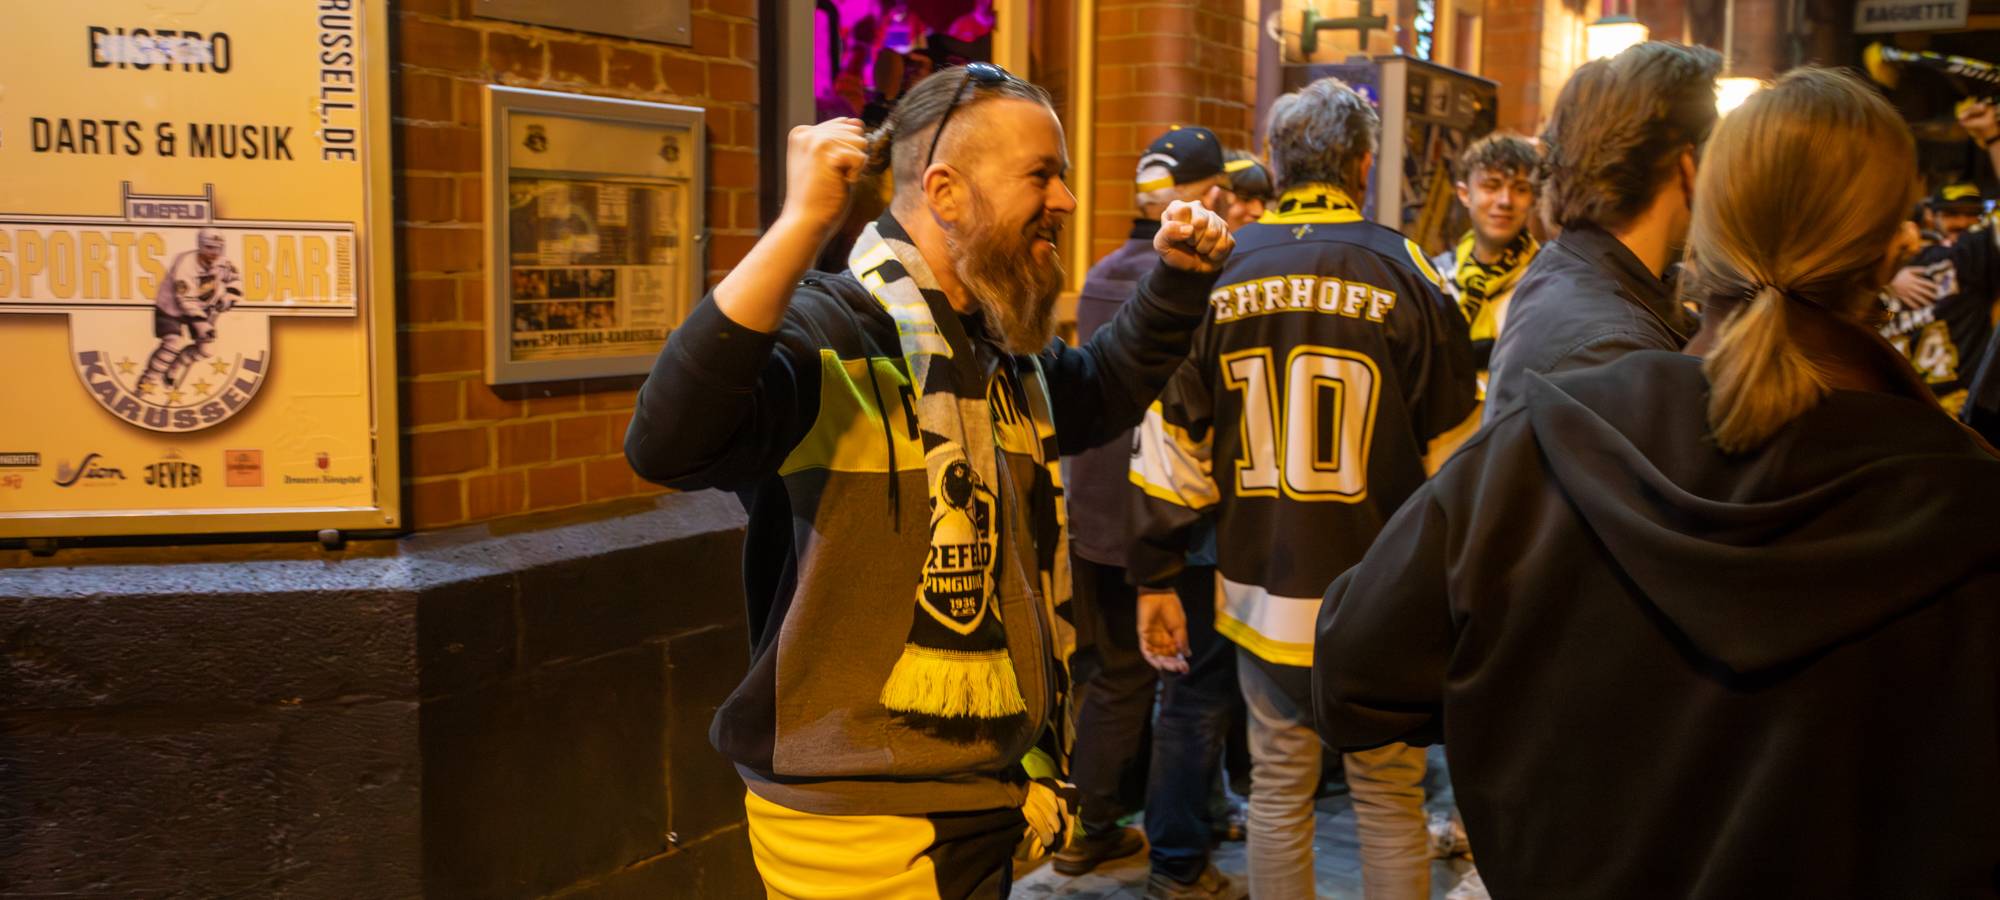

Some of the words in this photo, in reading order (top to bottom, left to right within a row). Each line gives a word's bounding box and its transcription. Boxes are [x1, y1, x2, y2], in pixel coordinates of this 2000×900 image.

[30, 117, 142, 155] DARTS
[155, 122, 176, 156] &
[188, 123, 293, 161] MUSIK
[244, 233, 329, 300] BAR
[1211, 275, 1397, 324] EHRHOFF
[79, 350, 265, 429] KARUSSELL
[1219, 345, 1381, 503] 10
[144, 462, 202, 488] JEVER
